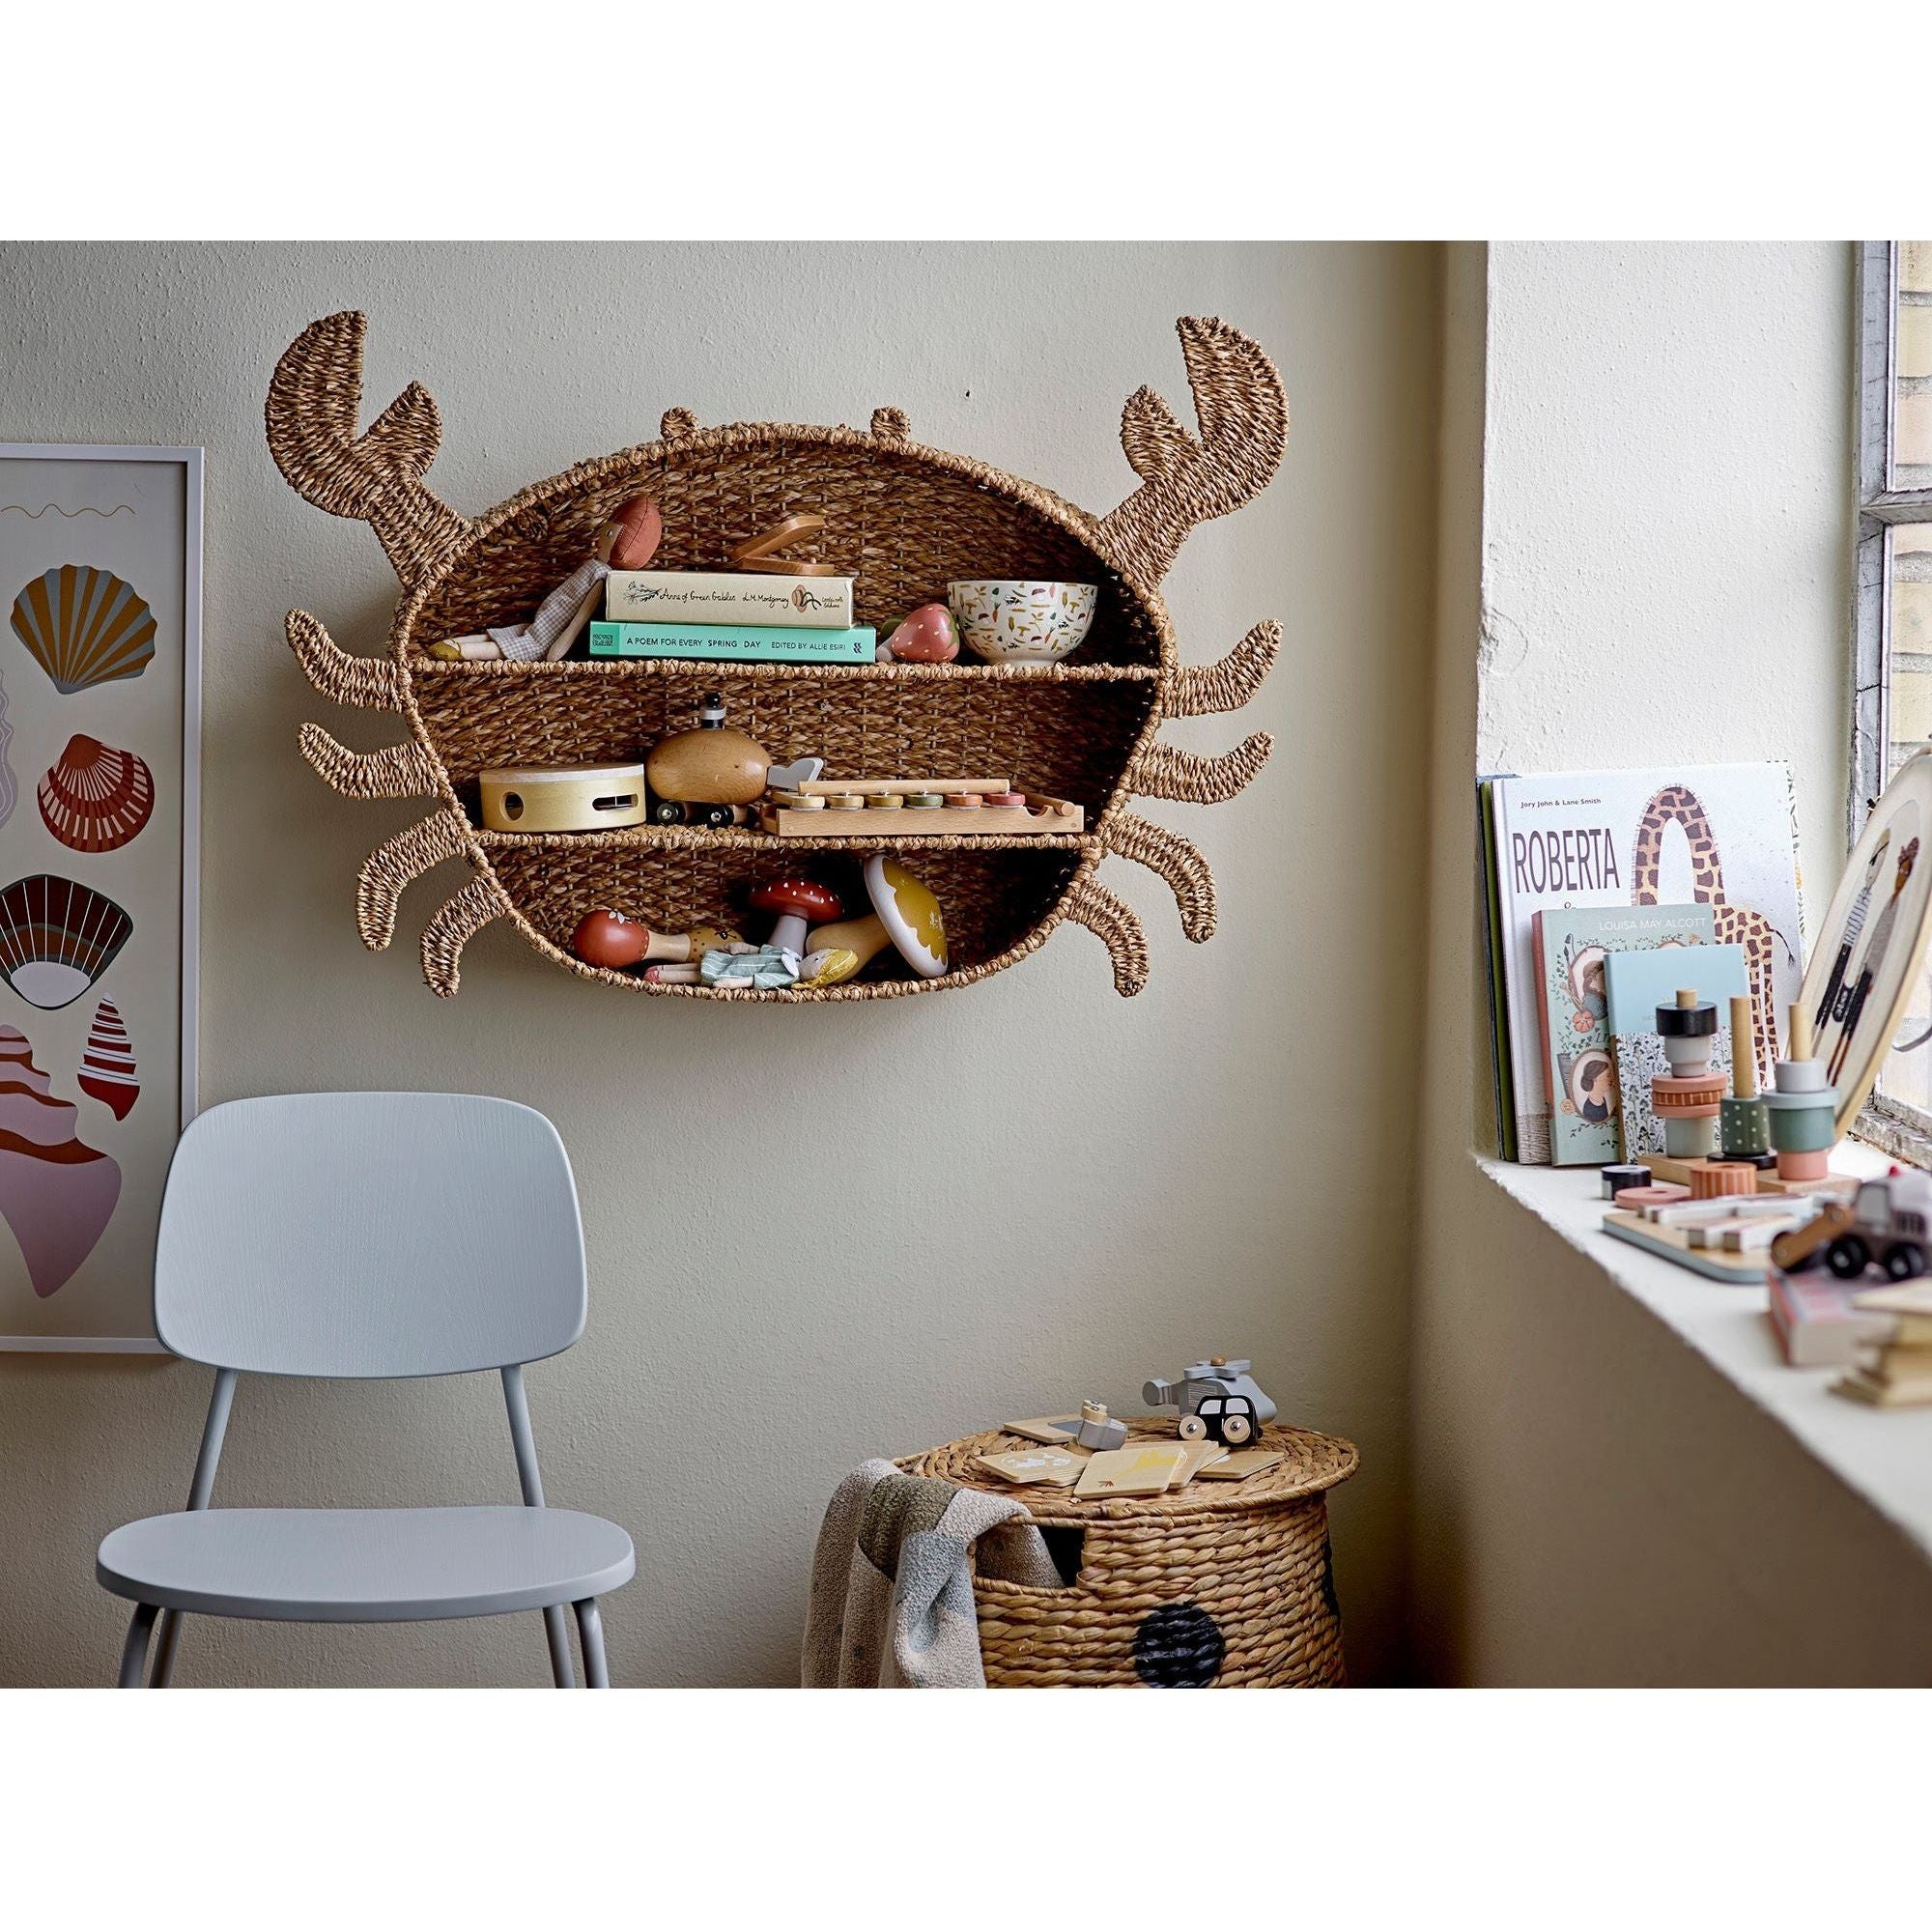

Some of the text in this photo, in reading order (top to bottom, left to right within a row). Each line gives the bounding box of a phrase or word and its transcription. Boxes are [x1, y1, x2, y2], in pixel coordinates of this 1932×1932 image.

[659, 587, 680, 600] Anne
[681, 592, 688, 603] of
[690, 590, 710, 601] Green
[678, 639, 703, 647] EVERY
[707, 639, 738, 648] SPRING
[1512, 828, 1621, 894] ROBERTA
[1599, 917, 1707, 931] LOUISA MAY ALCOTT
